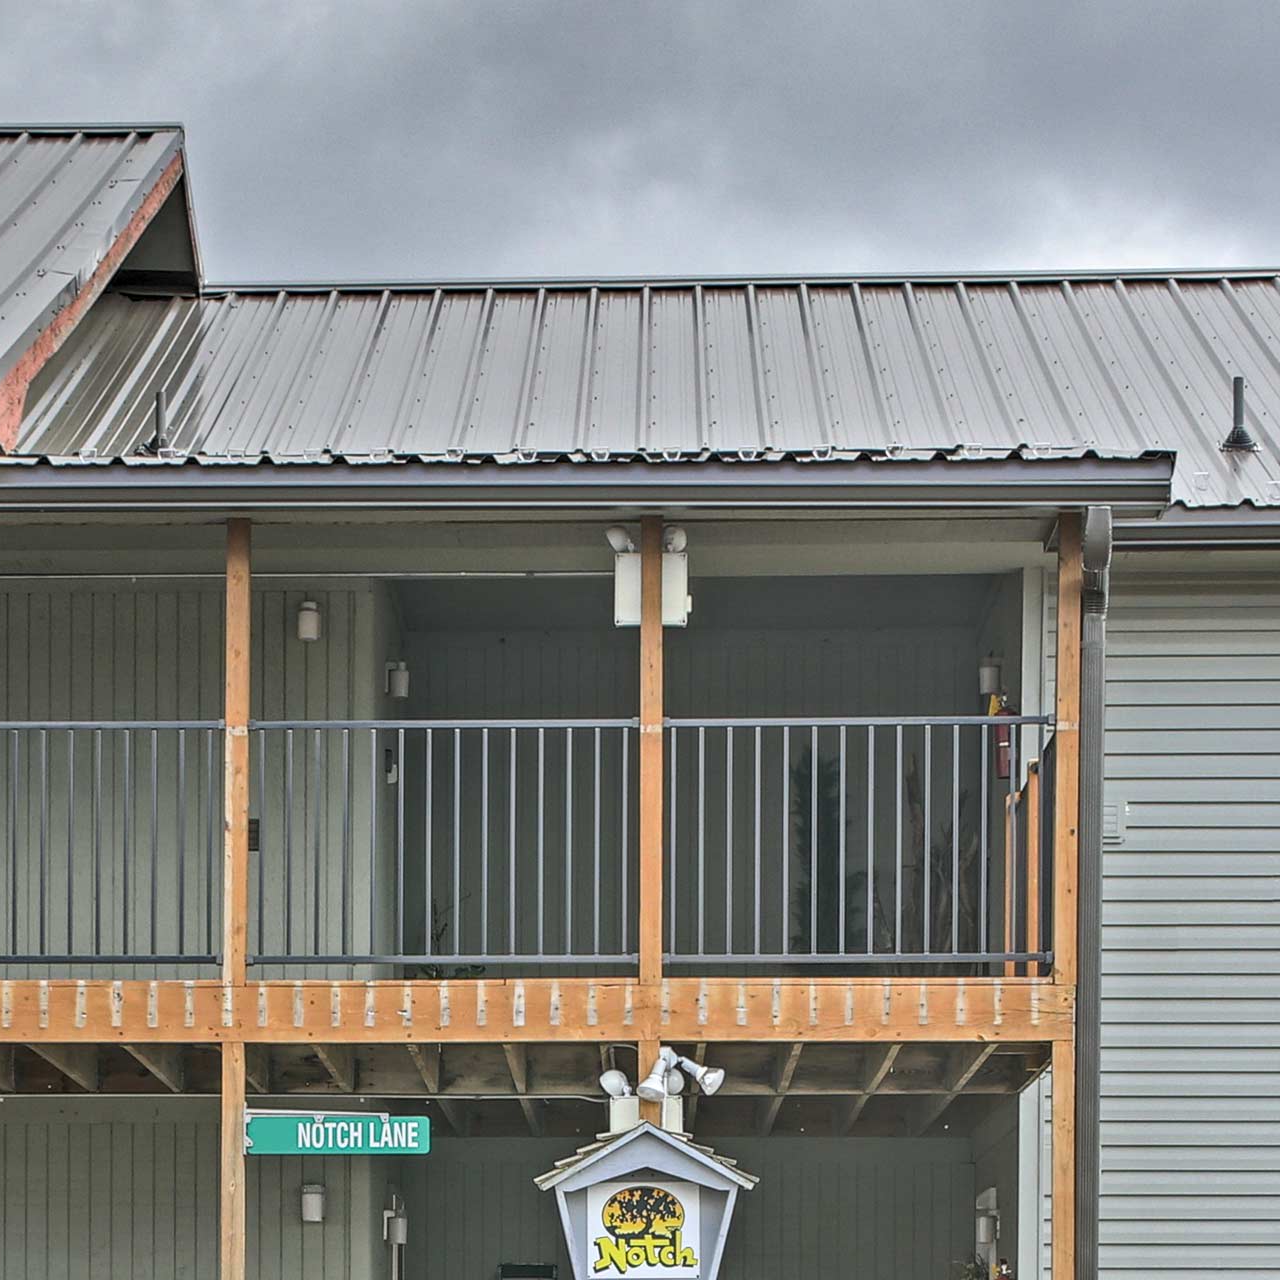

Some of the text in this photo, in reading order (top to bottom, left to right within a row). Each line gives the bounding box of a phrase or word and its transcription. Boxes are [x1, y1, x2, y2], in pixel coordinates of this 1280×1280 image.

[297, 1121, 419, 1149] NOTCH LANE
[593, 1229, 699, 1275] Notch
